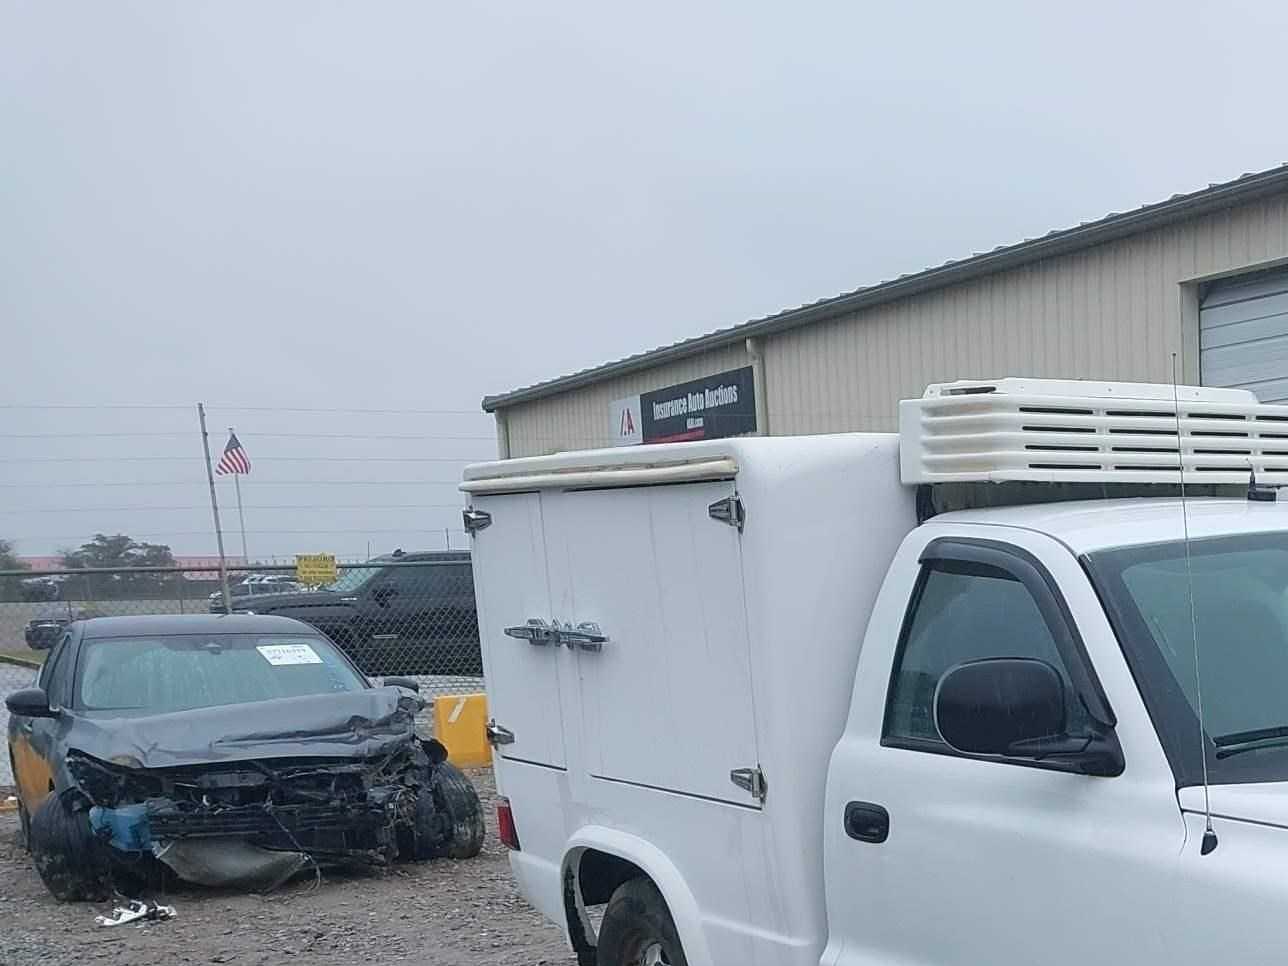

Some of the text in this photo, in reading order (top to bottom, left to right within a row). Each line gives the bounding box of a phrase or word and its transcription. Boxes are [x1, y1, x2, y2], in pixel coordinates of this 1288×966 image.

[653, 384, 738, 420] Insurance Auto Auctions
